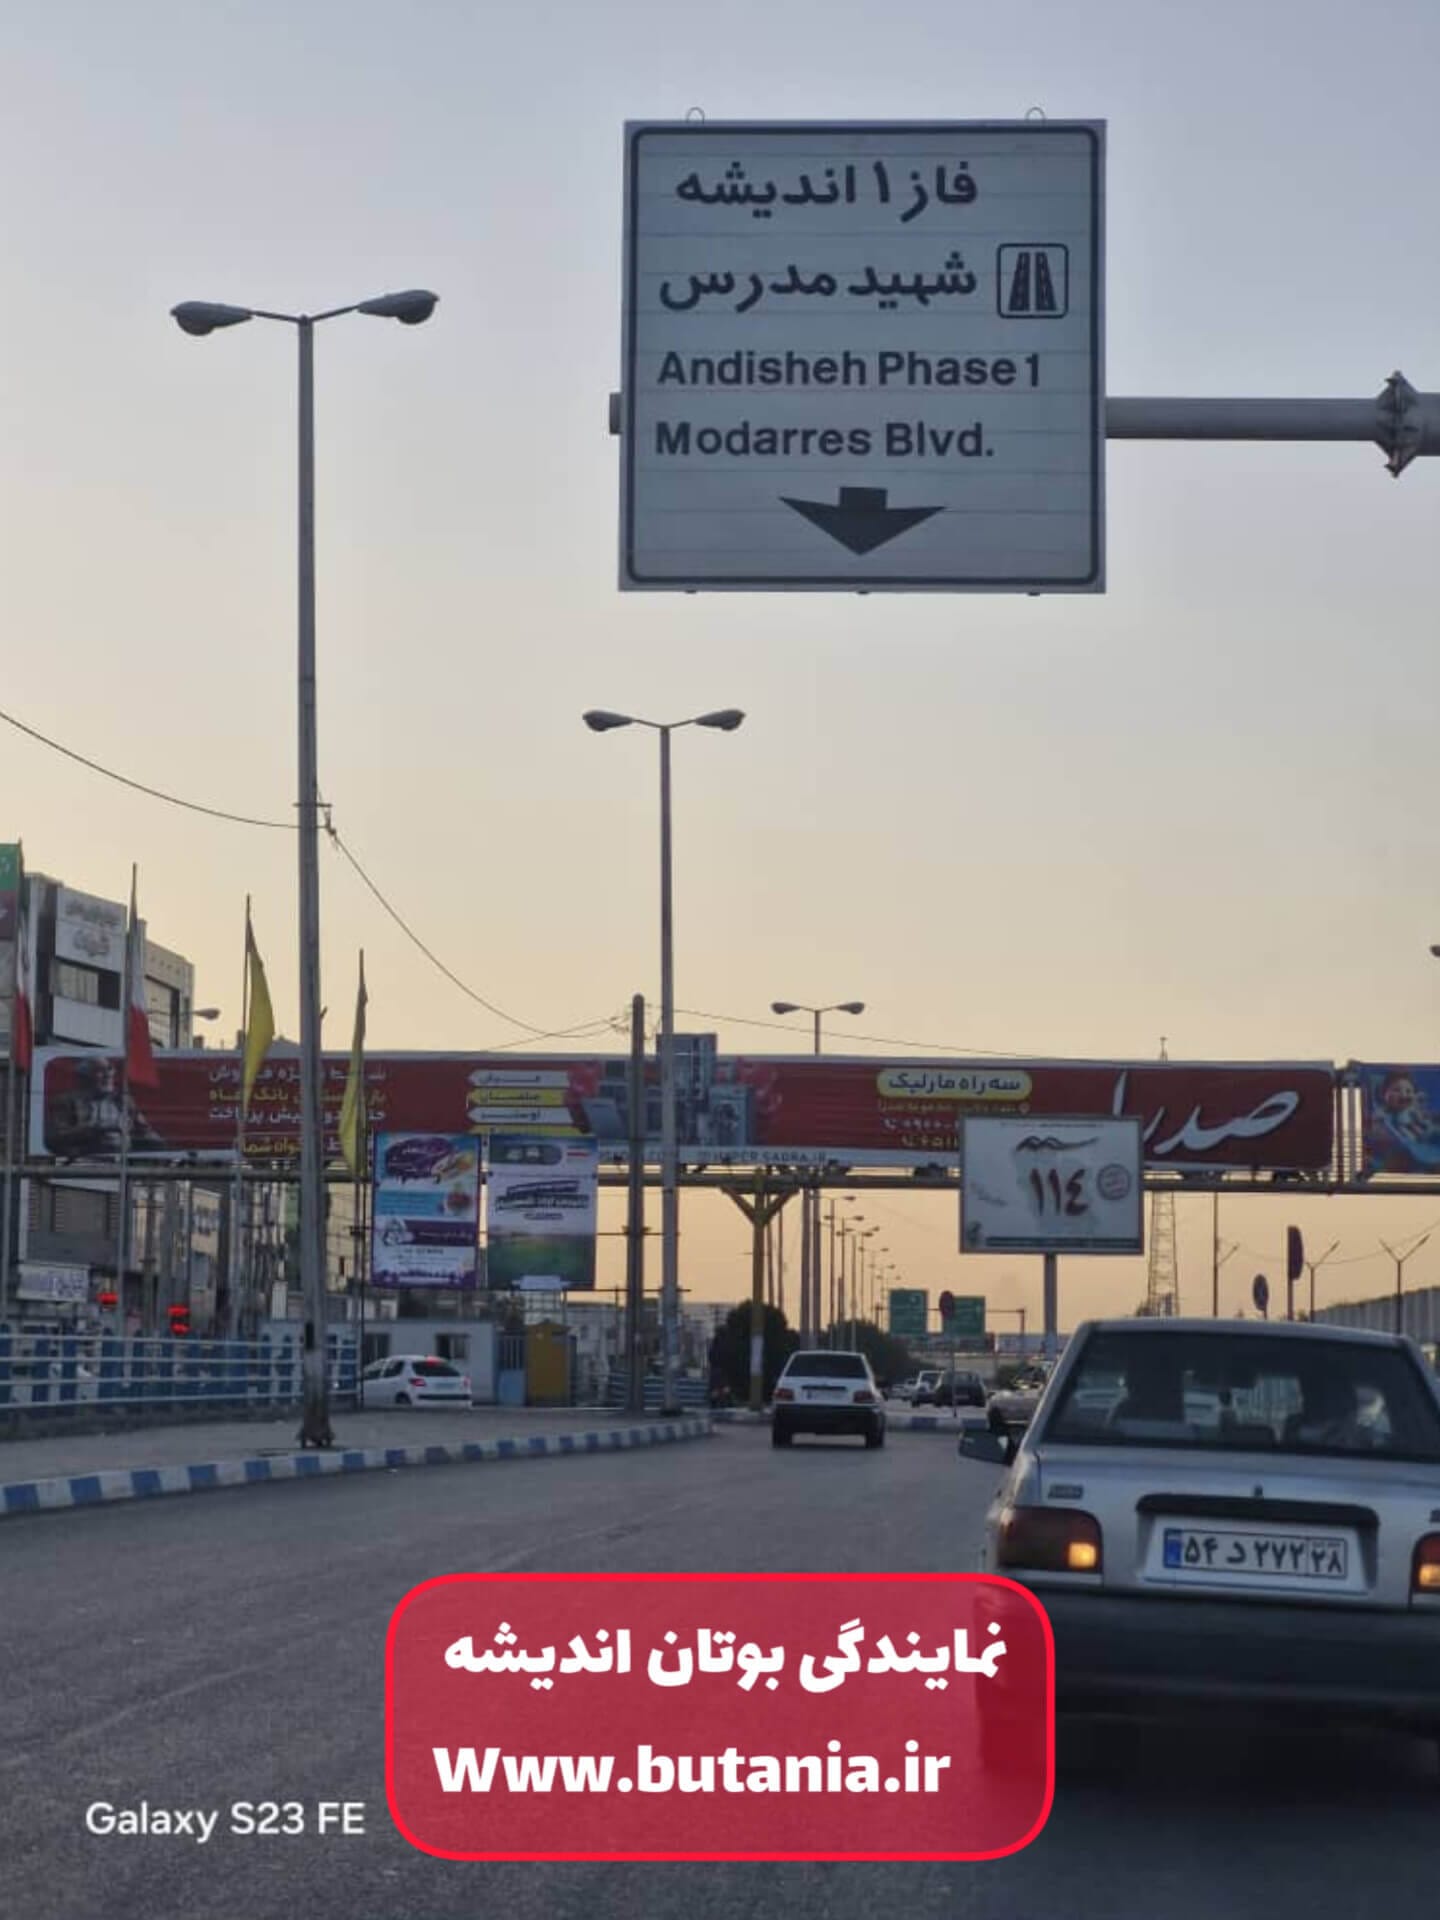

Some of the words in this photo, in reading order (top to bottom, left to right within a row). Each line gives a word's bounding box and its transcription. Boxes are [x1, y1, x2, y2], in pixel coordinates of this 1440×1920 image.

[676, 161, 856, 219] اندیشه
[873, 161, 890, 204] ۱
[901, 161, 978, 223] فاز
[659, 265, 838, 313] مدرس
[847, 251, 977, 309] شهید
[657, 350, 866, 386] Andisheh
[656, 421, 871, 457] Modarres
[886, 421, 993, 457] Blvd.
[888, 1072, 956, 1094] مارلیک
[957, 1074, 986, 1095] راه
[988, 1076, 1021, 1091] سه
